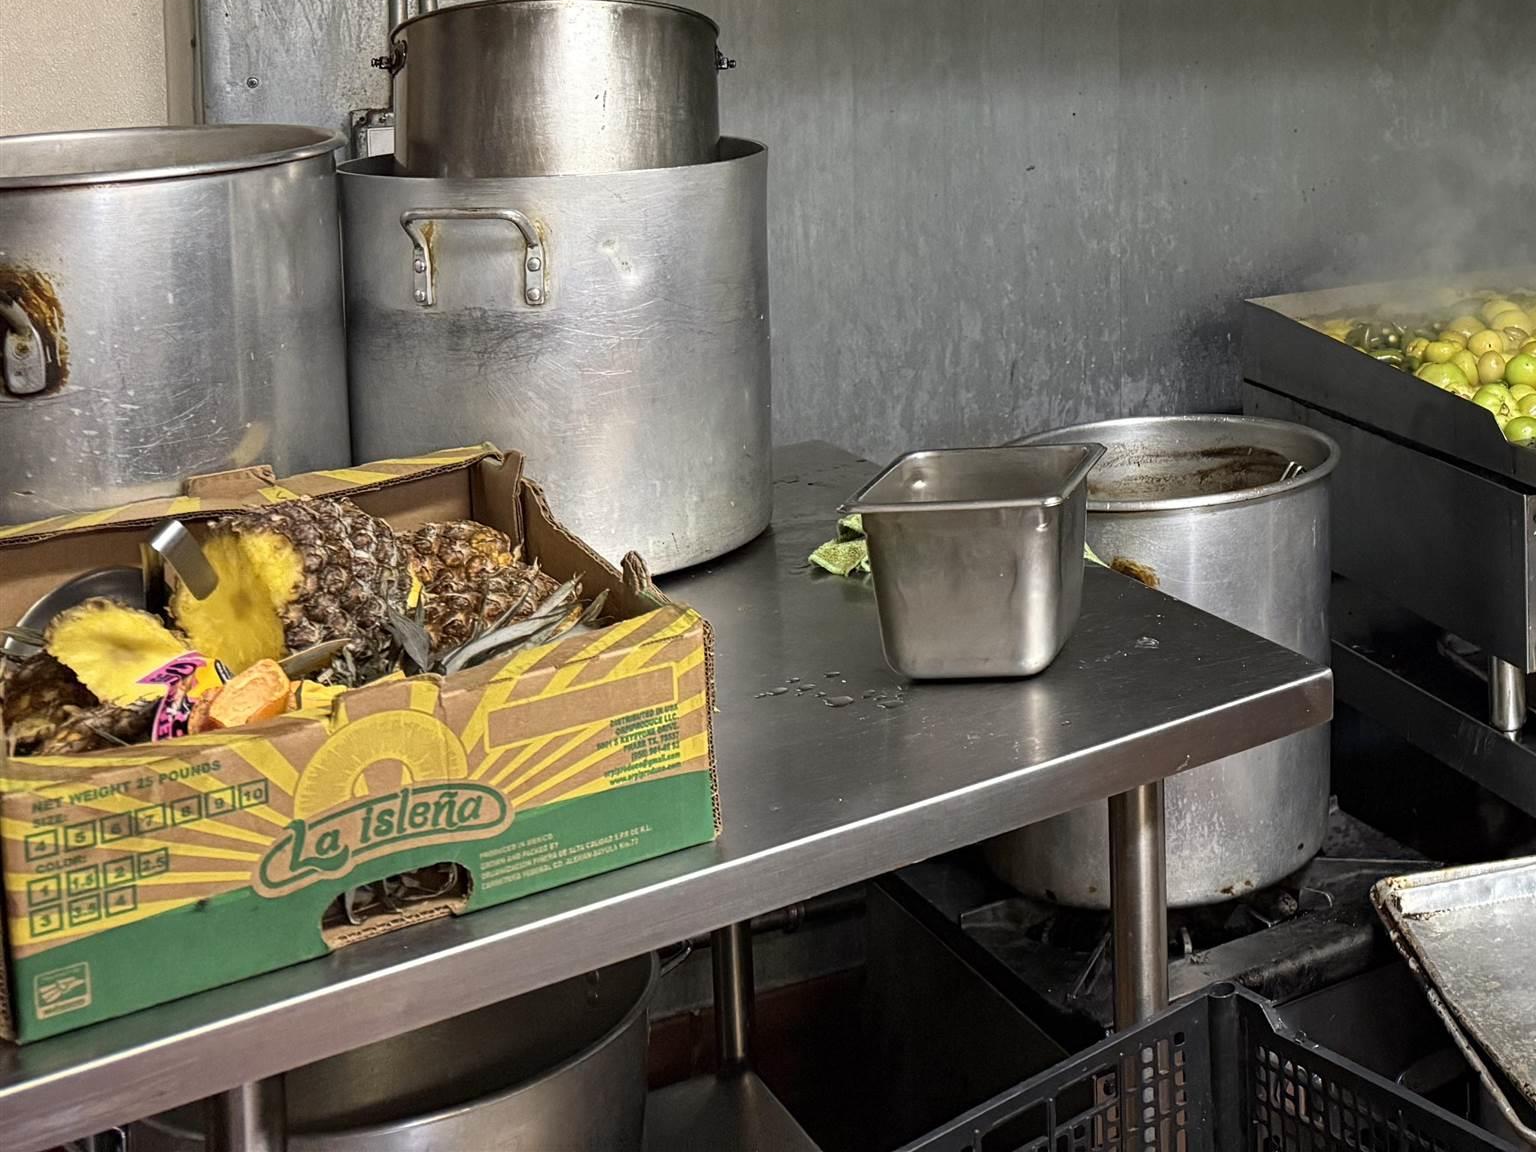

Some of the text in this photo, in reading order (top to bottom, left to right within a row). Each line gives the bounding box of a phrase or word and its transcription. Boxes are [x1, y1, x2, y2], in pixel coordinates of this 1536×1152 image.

[32, 797, 65, 815] NET
[69, 781, 131, 806] WEIGHT
[158, 760, 222, 785] POUNDS
[35, 787, 263, 852] 4 5 6 7 8 9 10
[35, 855, 87, 873] COLOR:
[288, 818, 349, 873] La
[41, 884, 49, 897] 1
[71, 873, 94, 889] 1.5
[114, 865, 125, 879] 2
[40, 914, 51, 927] 3
[113, 894, 126, 906] 4
